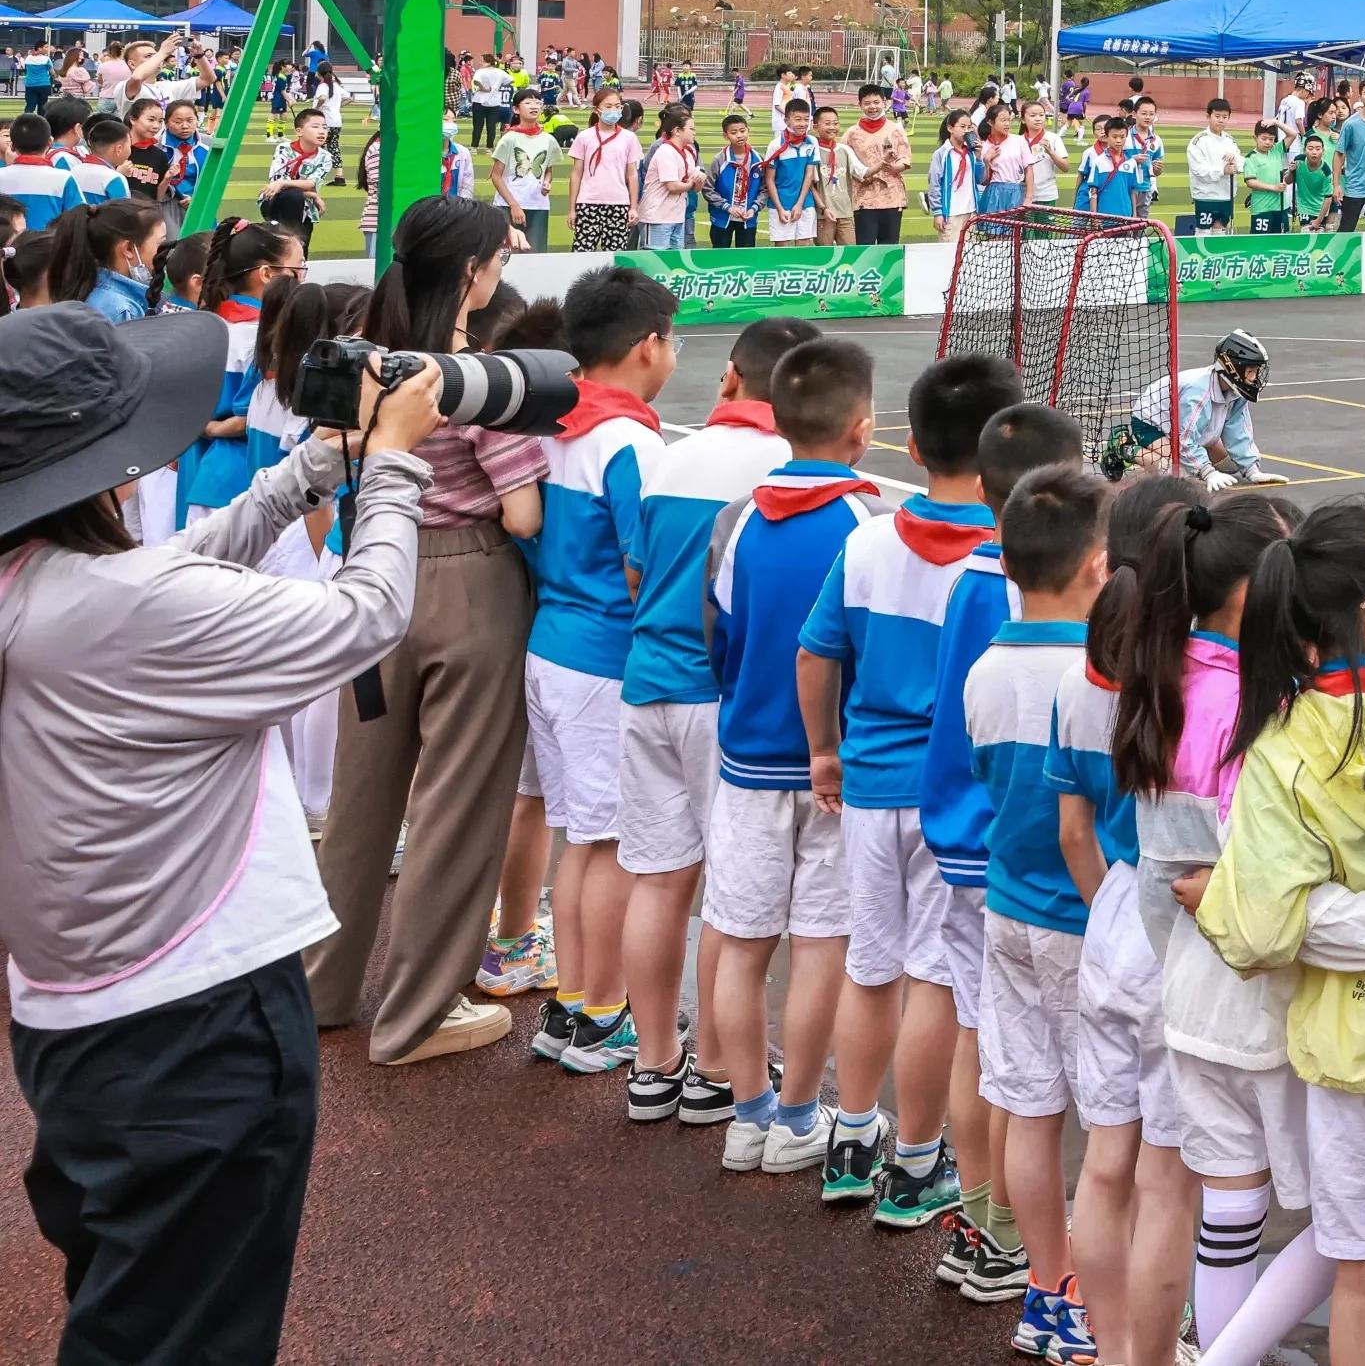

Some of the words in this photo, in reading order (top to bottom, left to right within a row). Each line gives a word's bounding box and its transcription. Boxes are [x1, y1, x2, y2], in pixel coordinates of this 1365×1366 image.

[1200, 212, 1213, 225] 26
[1255, 218, 1270, 232] 35
[1177, 253, 1336, 282] 成都市体育总会
[636, 1073, 657, 1084] NIKE
